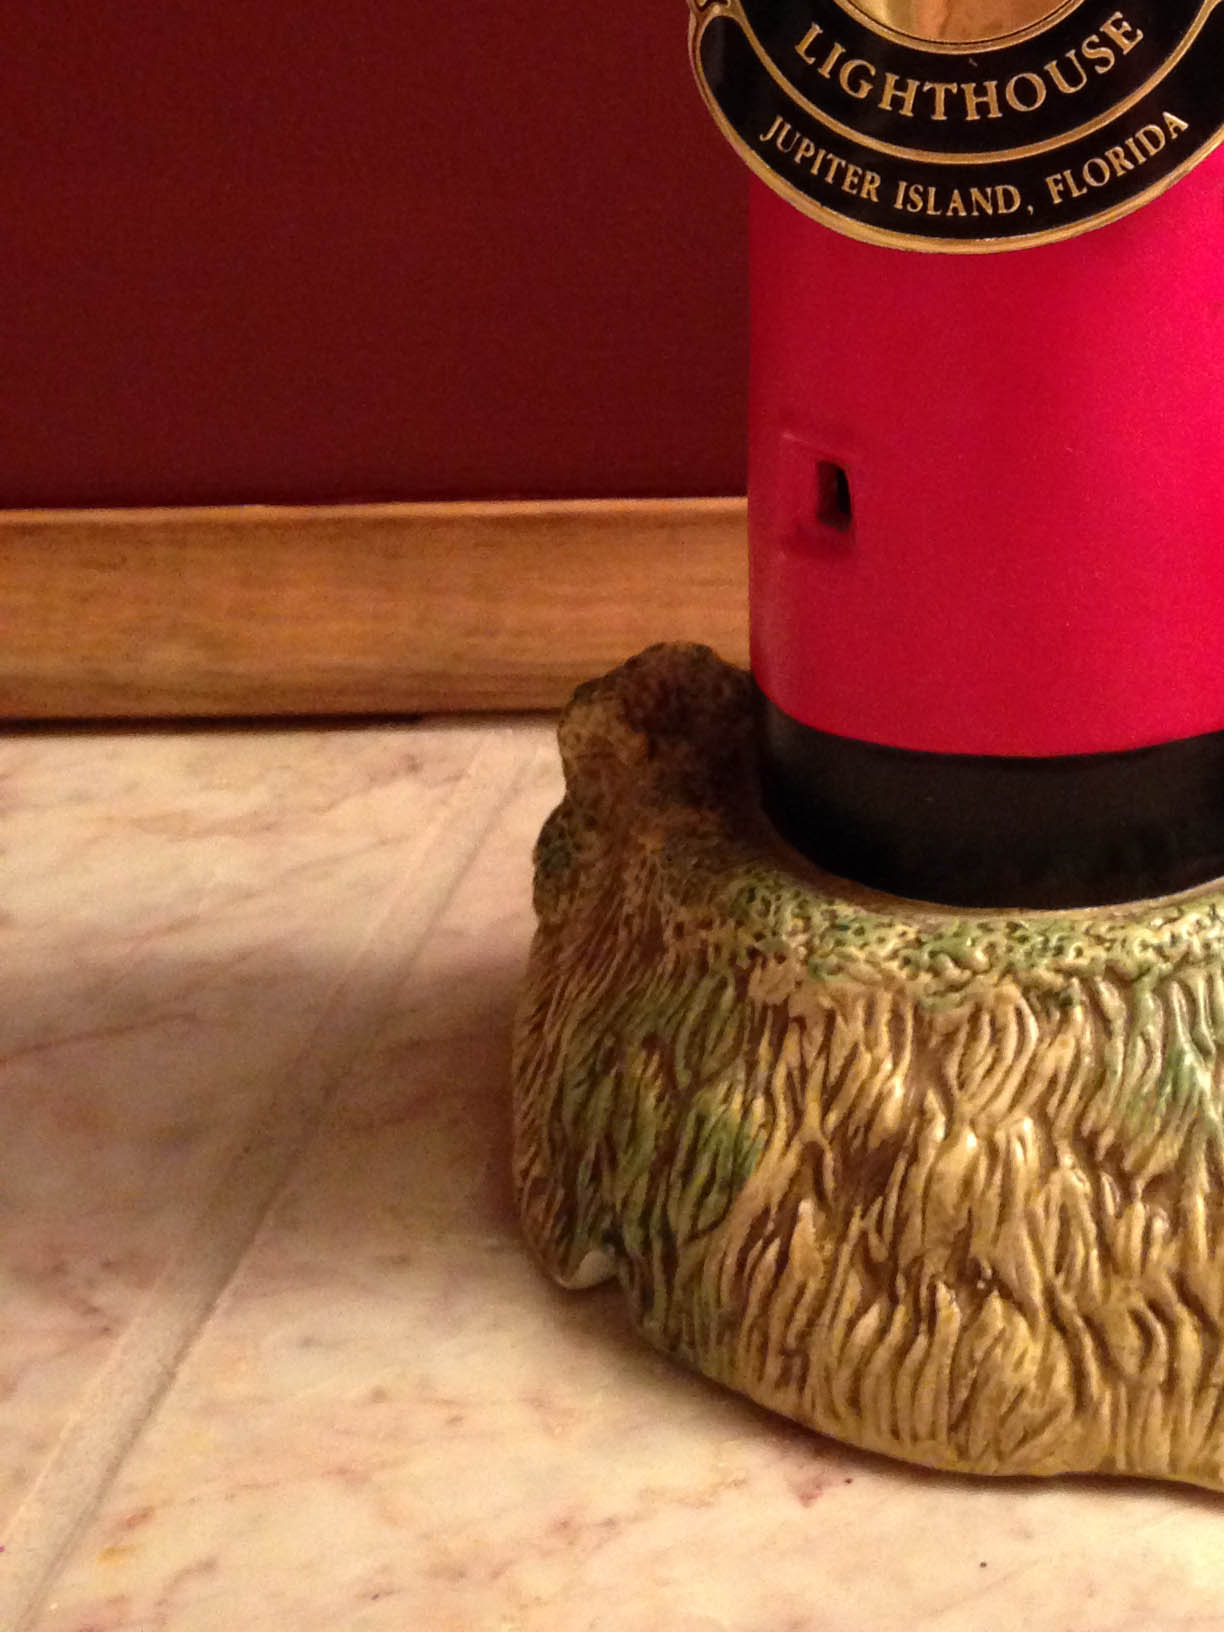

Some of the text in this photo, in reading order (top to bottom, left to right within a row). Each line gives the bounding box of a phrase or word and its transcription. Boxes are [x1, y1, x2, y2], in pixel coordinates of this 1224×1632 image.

[794, 11, 1144, 121] LIGHTHOUSE
[760, 110, 1189, 218] JUPITER ISLAND, FLORIDA
